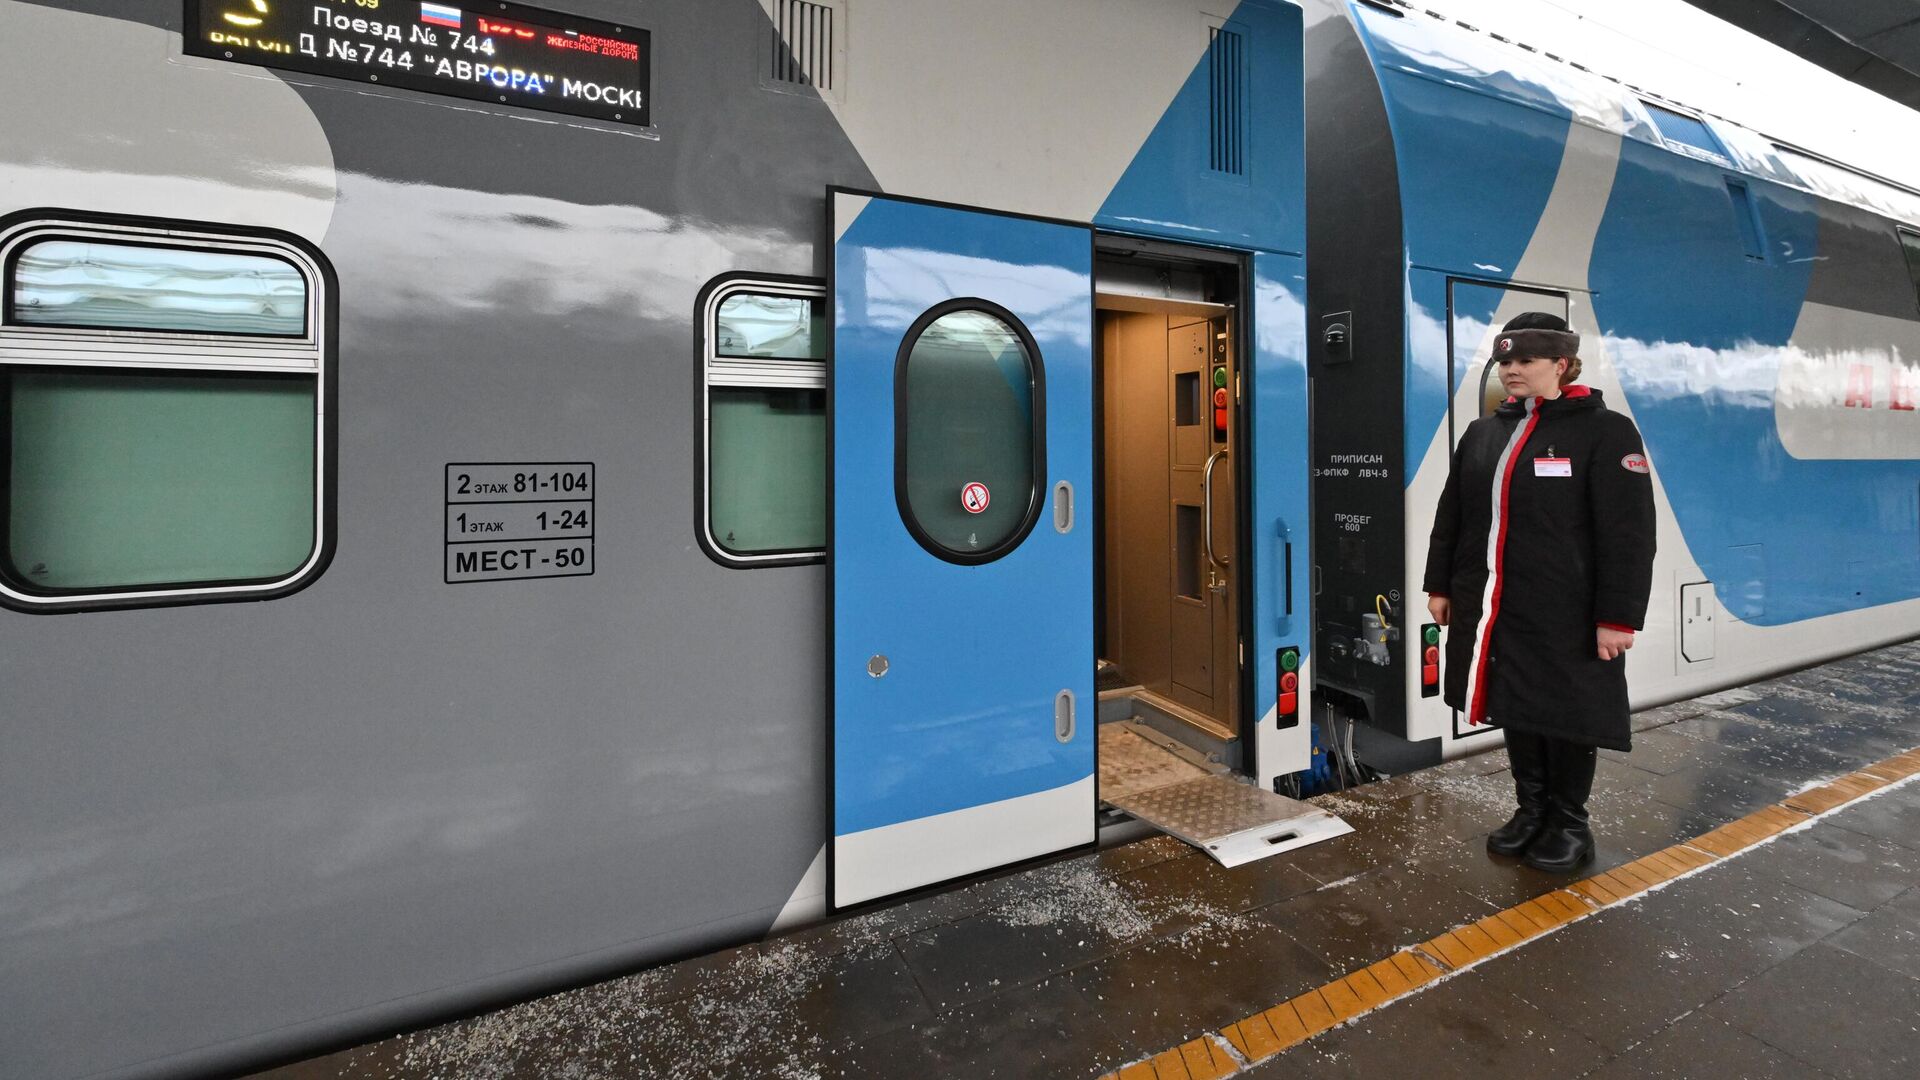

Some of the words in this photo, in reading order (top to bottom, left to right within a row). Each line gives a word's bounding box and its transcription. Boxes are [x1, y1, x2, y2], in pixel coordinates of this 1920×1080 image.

[314, 6, 402, 43] Поезд
[409, 24, 438, 47] №
[448, 31, 495, 56] 744
[547, 35, 598, 54] ЖЕЛЕЗНЫЕ
[601, 47, 639, 61] ДОРОГИ
[579, 34, 639, 52] РОССИЙСКИЕ
[1330, 454, 1383, 464] ПРИПИСАН
[457, 474, 471, 494] 2
[474, 483, 508, 494] ЭТАЖ
[513, 472, 588, 493] 81-104
[1358, 469, 1388, 478] ЛВЧ-8
[456, 513, 466, 533] 1
[470, 522, 504, 532] ЭТАЖ
[1334, 513, 1372, 525] ПРОБЕГ
